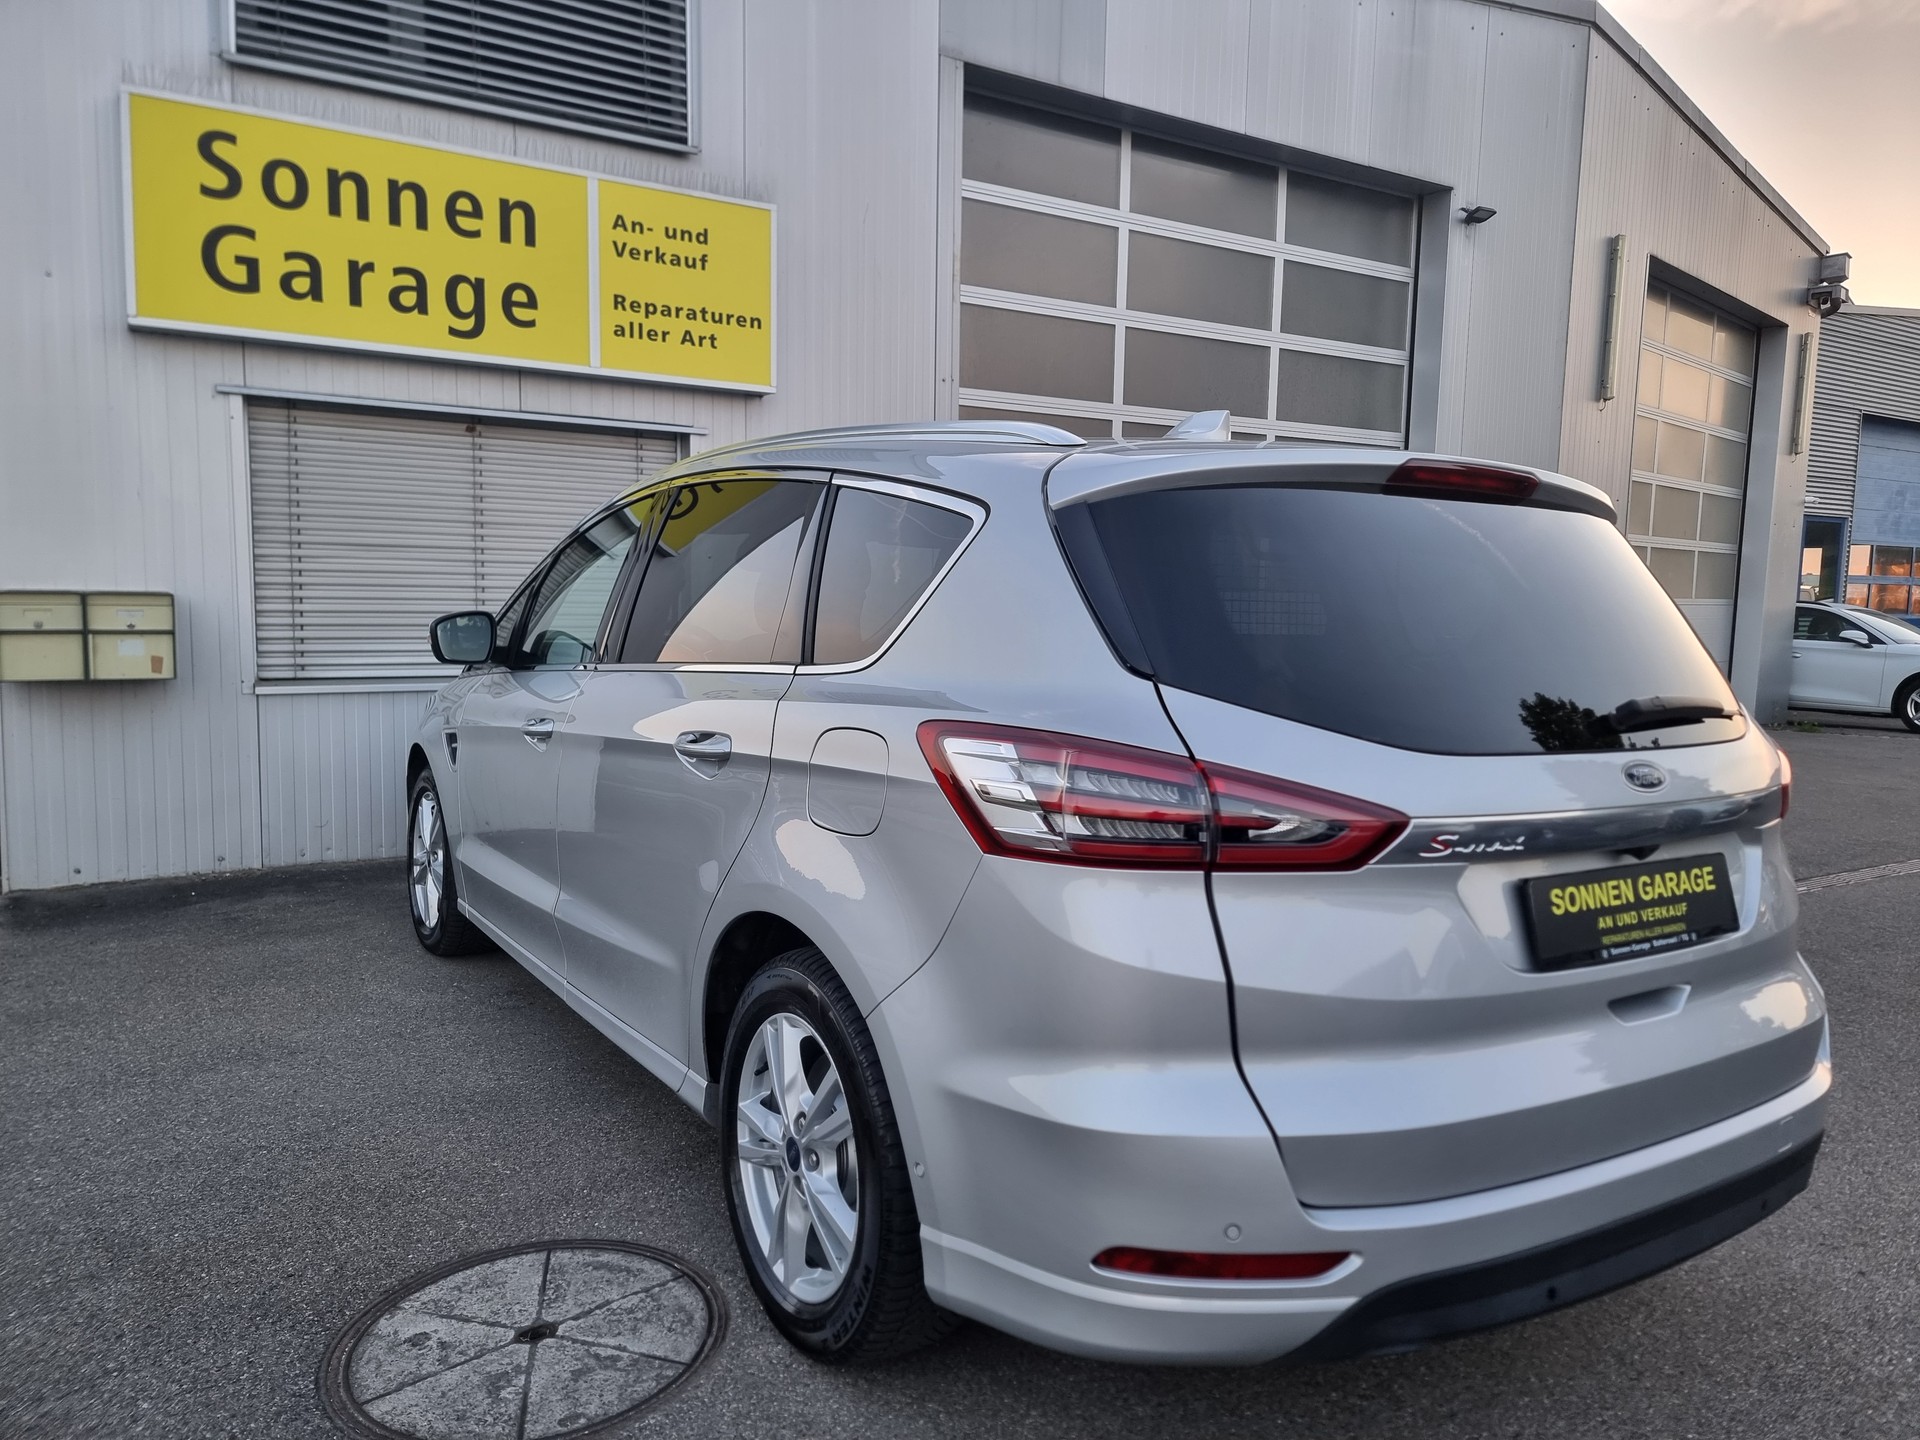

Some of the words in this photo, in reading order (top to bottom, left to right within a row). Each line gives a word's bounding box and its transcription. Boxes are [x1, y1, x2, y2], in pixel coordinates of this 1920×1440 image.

[196, 129, 538, 249] Sonnen
[612, 213, 655, 236] An-
[664, 226, 710, 246] und
[612, 240, 709, 271] Verkauf
[200, 224, 540, 340] Garage
[613, 293, 763, 331] Reparaturen
[613, 321, 671, 344] aller
[680, 329, 718, 350] Art
[1550, 878, 1636, 916] SONNEN
[1637, 865, 1717, 901] GARAGE
[1597, 916, 1615, 930] AN
[1616, 911, 1640, 927] UND
[1641, 902, 1688, 922] VERKAUF
